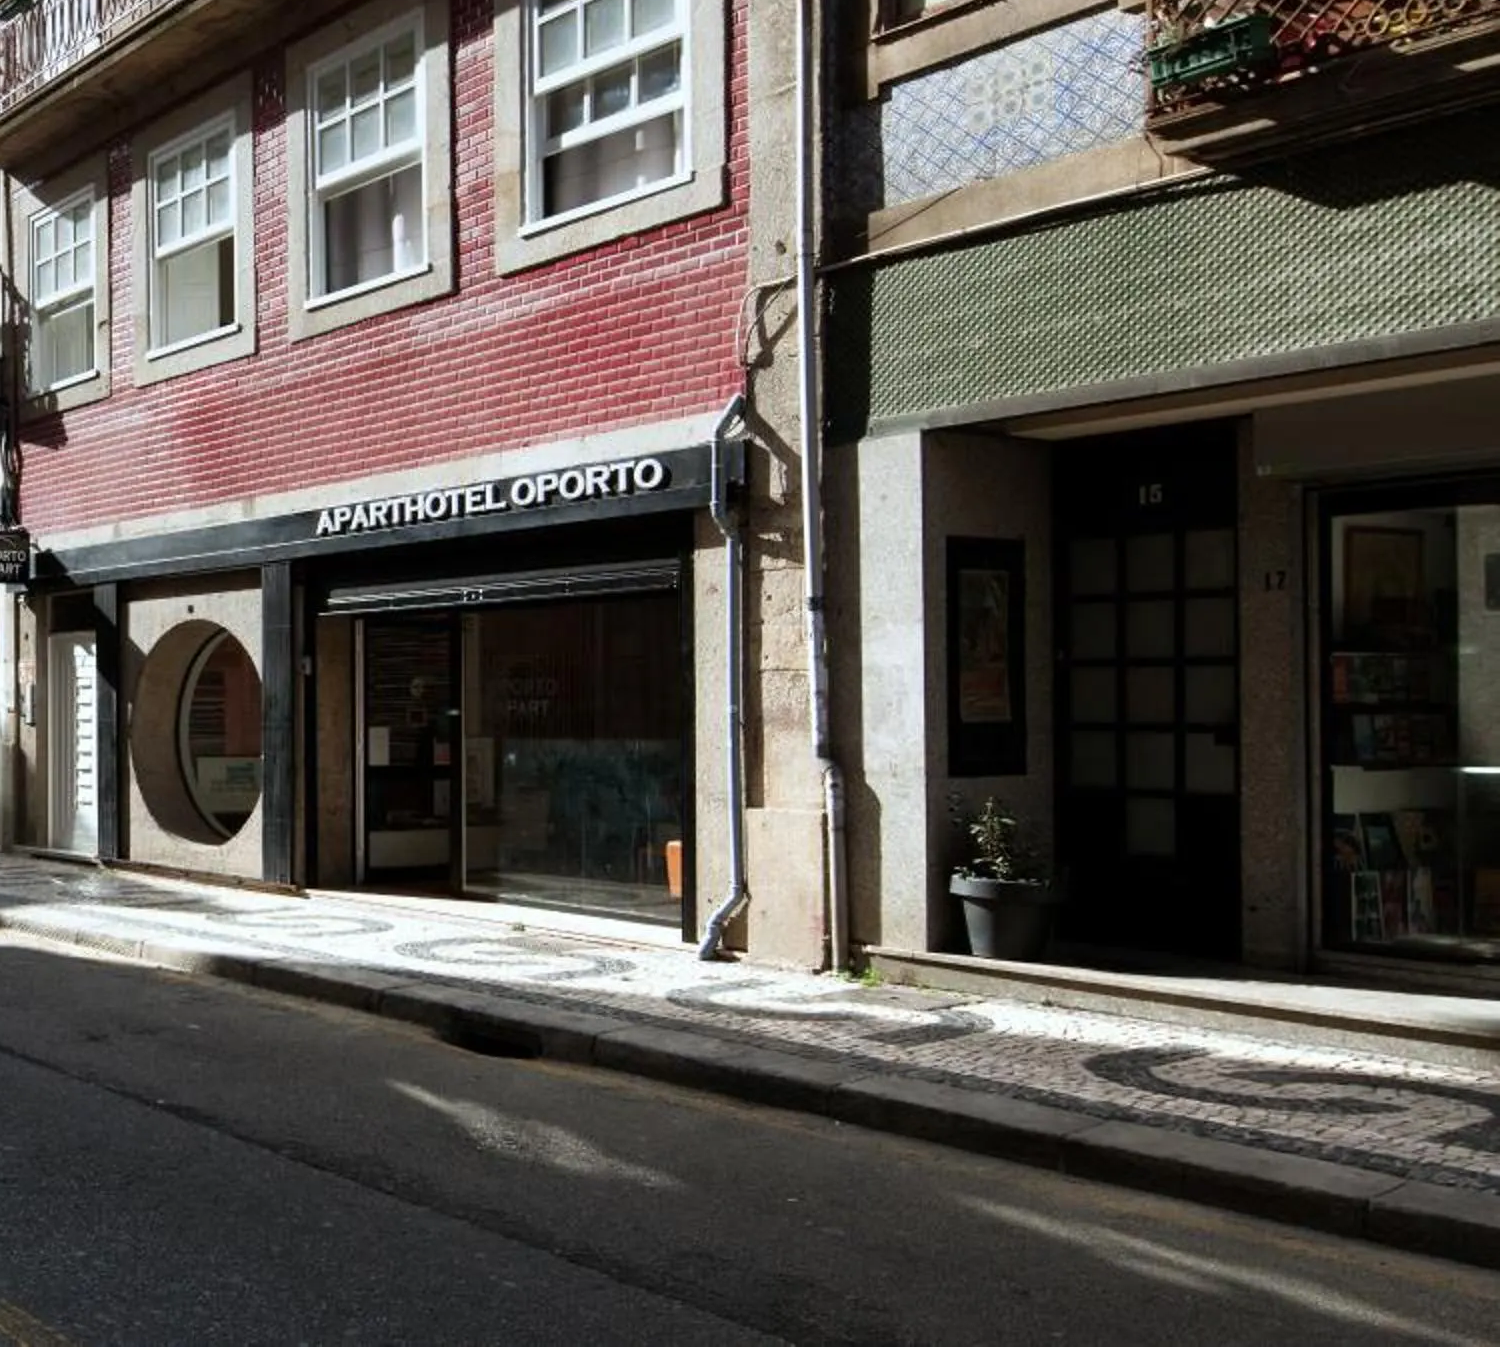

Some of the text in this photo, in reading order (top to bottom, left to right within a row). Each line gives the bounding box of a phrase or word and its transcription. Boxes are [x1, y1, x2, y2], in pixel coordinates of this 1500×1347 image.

[315, 457, 664, 536] APARTHOTEL OPORTO
[1264, 570, 1286, 592] 17
